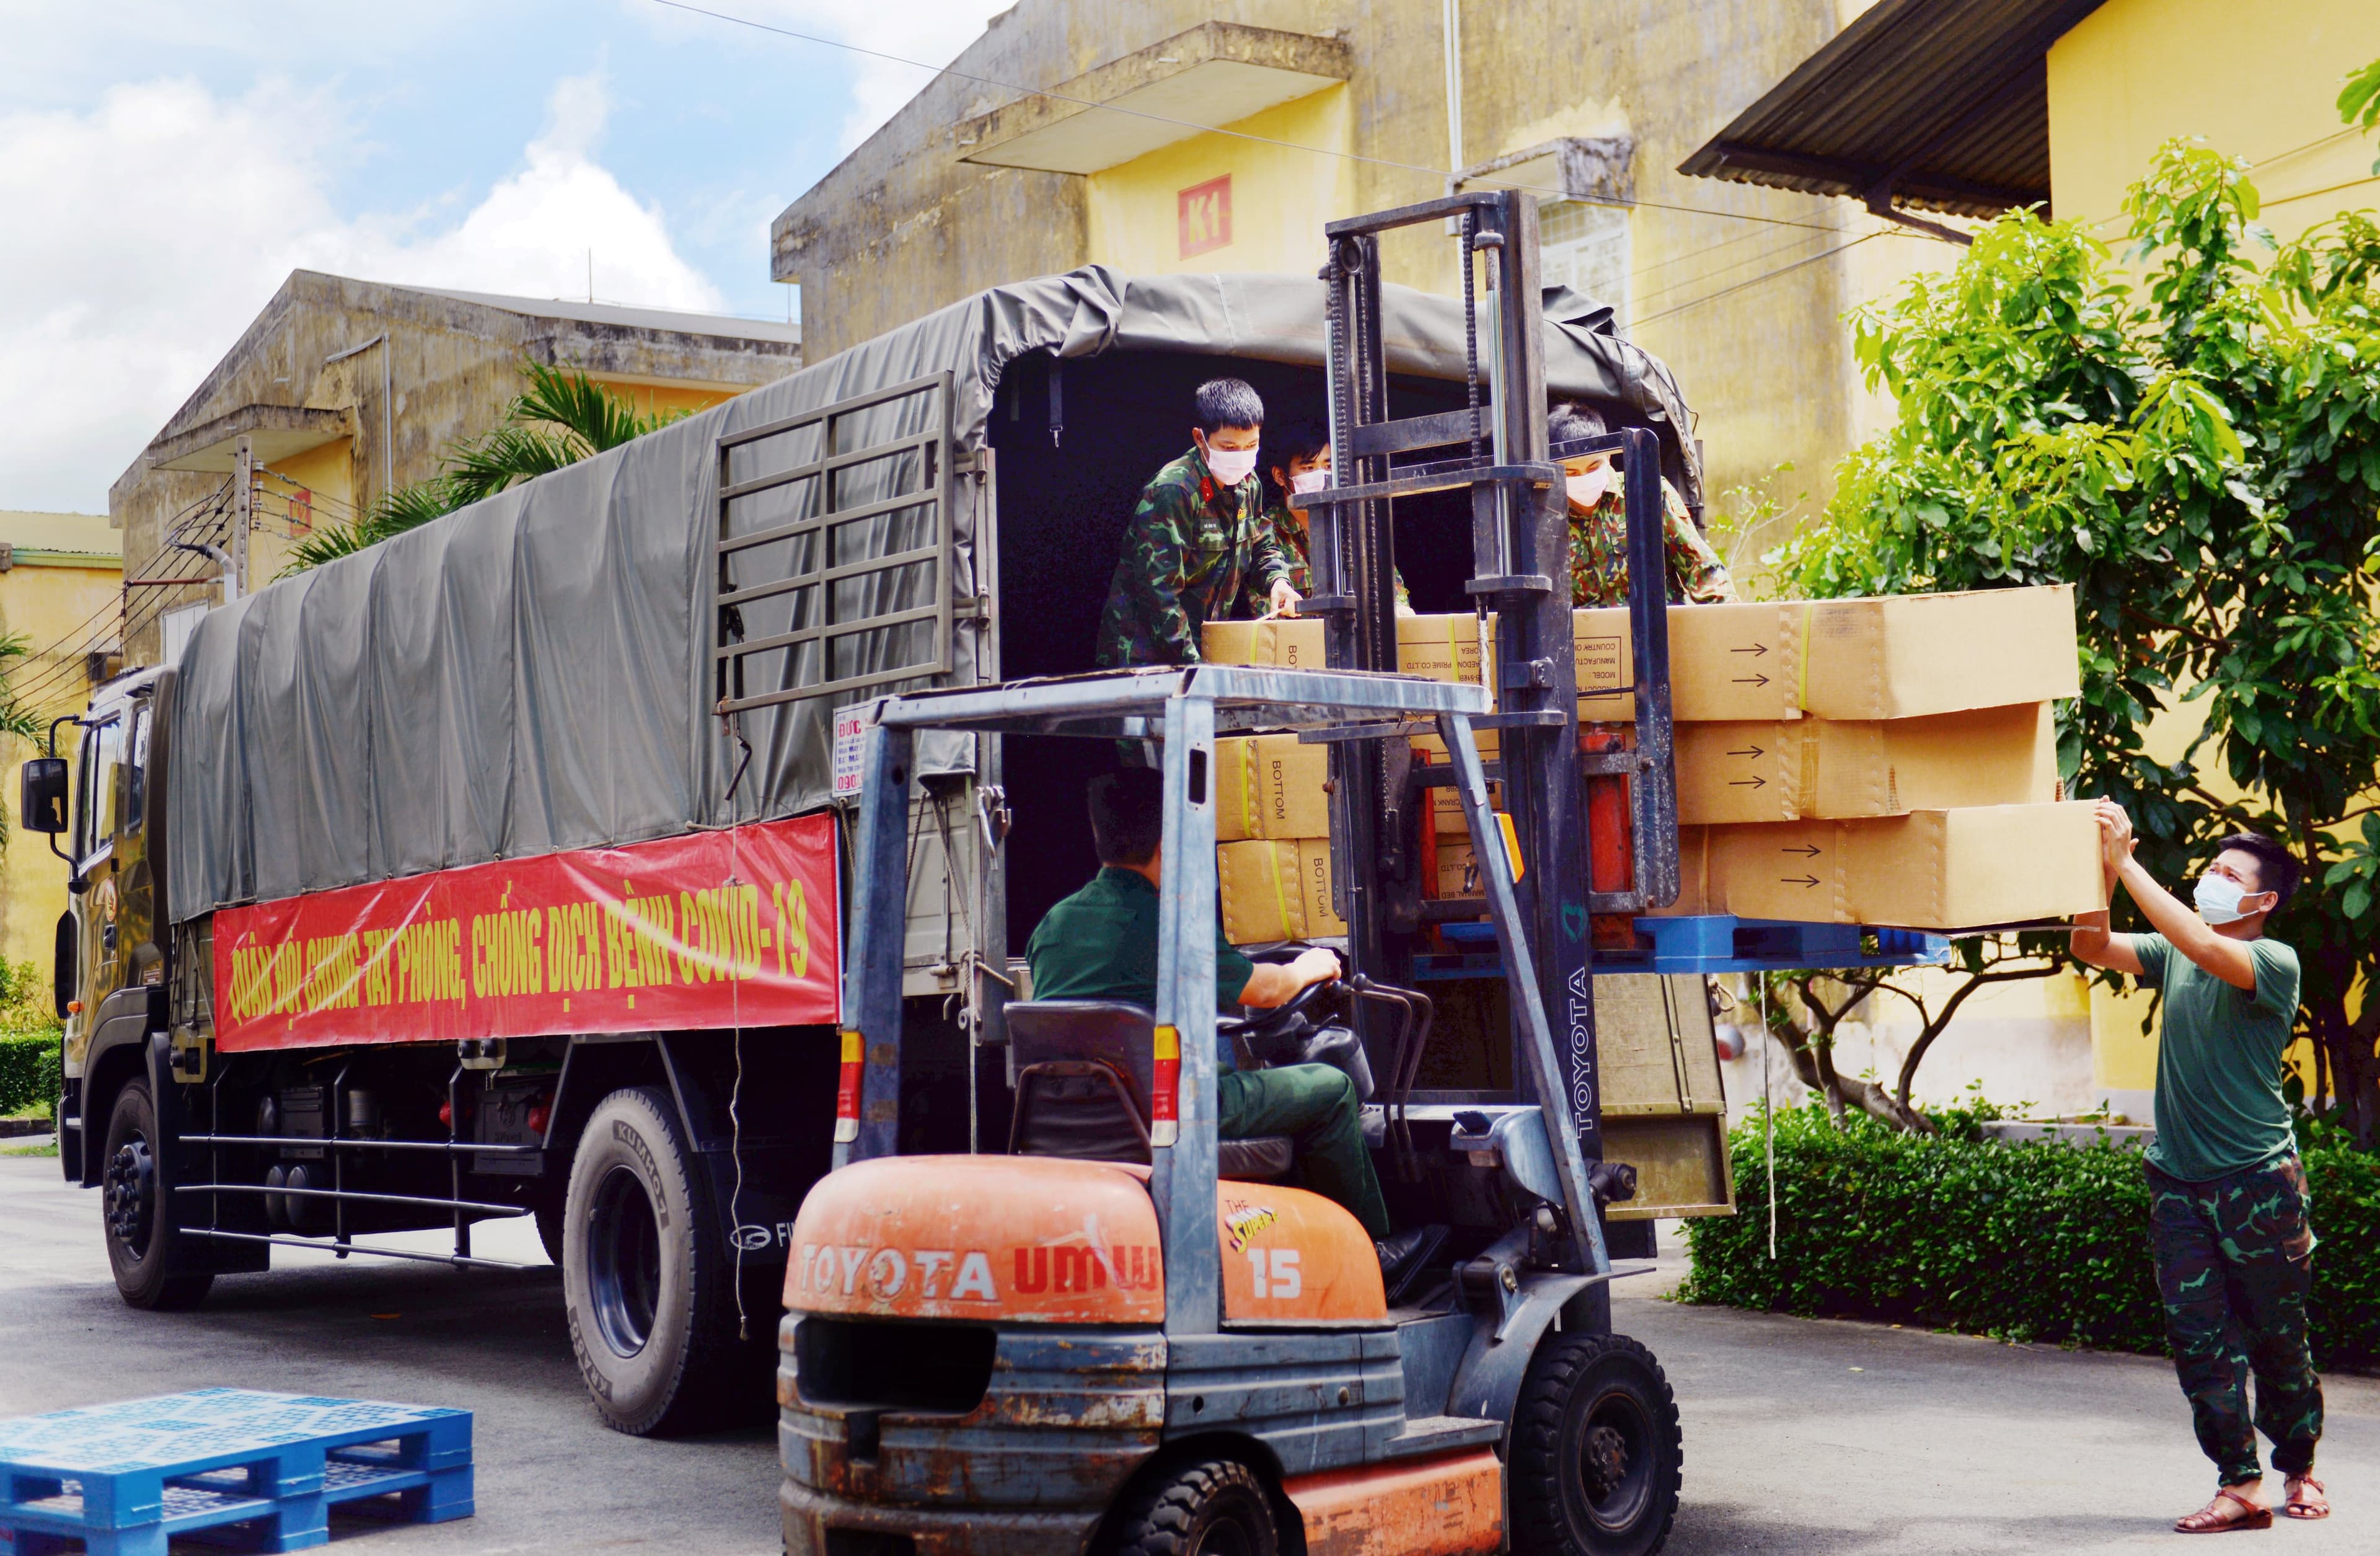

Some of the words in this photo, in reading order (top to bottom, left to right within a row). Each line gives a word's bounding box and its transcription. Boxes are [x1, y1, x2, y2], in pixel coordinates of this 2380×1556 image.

[1189, 191, 1220, 244] K1
[1289, 645, 1297, 669] BO
[1576, 657, 1616, 665] MANUFACTU
[1583, 643, 1616, 651] COUNTRY
[1272, 760, 1285, 820] BOTTOM
[1437, 798, 1461, 807] CRANK
[1313, 857, 1329, 917] BOTTOM
[1457, 890, 1484, 898] MANUAL
[229, 932, 273, 1027] QUÂN
[274, 926, 302, 1030] ĐỘI
[305, 933, 361, 1012] CHUNG
[364, 927, 395, 1006] TAY
[397, 901, 467, 1010] PHÒNG,
[472, 880, 542, 999] CHỐNG
[547, 901, 601, 1012] DỊCH
[604, 879, 674, 1009] BỆNH
[677, 878, 808, 986] COVID-19
[1569, 966, 1593, 1139] TOYOTA
[617, 1123, 661, 1196] KUMHO
[776, 1222, 795, 1247] FI
[1228, 1211, 1273, 1255] SUPER
[801, 1244, 998, 1301] TOYOTA
[1247, 1248, 1302, 1299] 15
